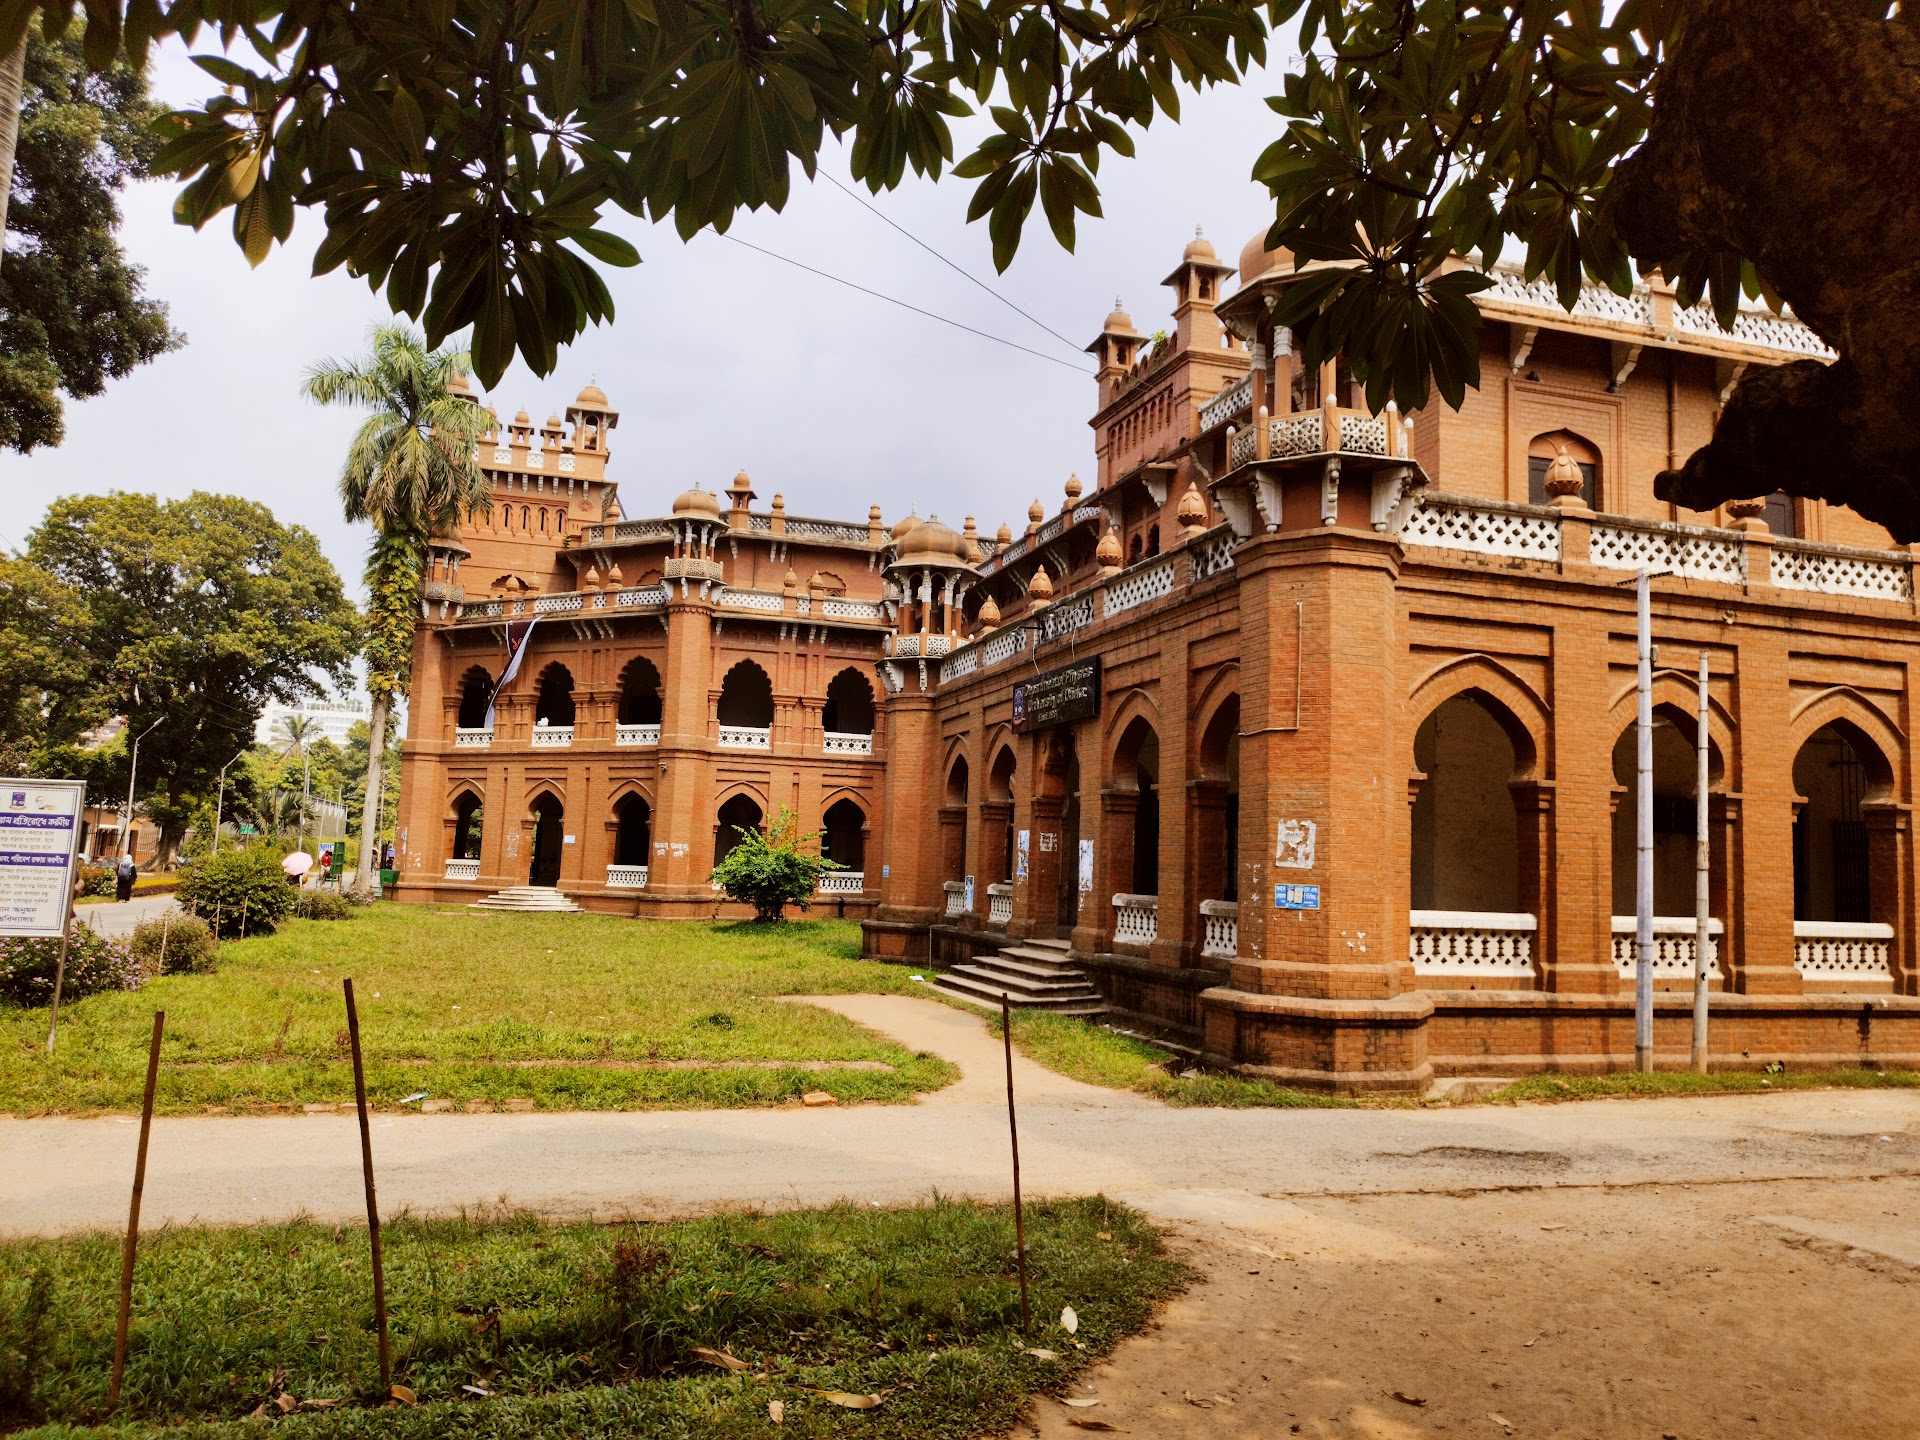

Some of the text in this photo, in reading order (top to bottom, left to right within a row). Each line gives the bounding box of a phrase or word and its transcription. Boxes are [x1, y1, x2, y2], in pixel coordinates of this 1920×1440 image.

[1024, 677, 1058, 698] Department
[1065, 666, 1093, 685] Physics
[1028, 693, 1055, 712] University
[13, 815, 46, 826] প্রতিরোধে
